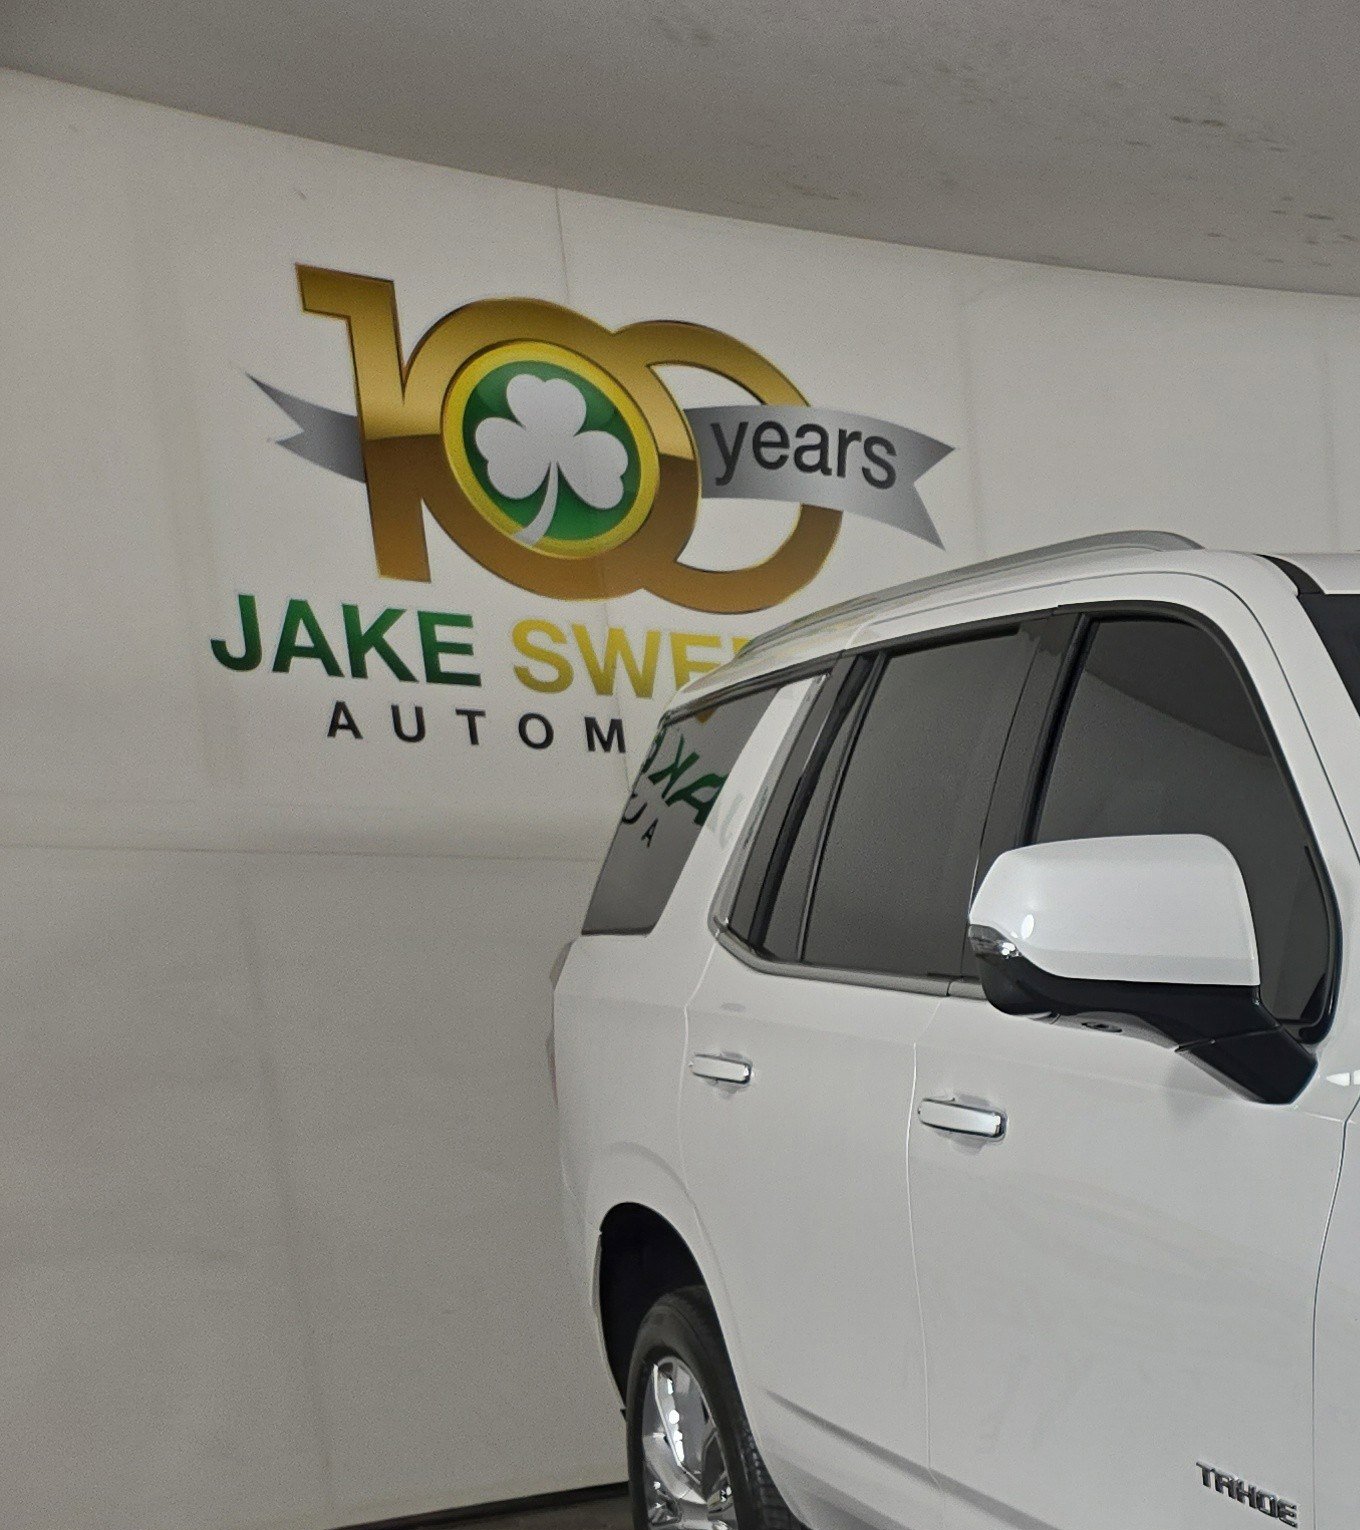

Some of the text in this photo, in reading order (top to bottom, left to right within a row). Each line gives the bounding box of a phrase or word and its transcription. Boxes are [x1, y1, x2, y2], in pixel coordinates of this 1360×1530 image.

[295, 264, 844, 616] 100
[710, 414, 898, 491] years
[210, 594, 482, 688] JAKE
[326, 700, 628, 755] AUTOM
[1195, 1460, 1299, 1529] TAHOE
